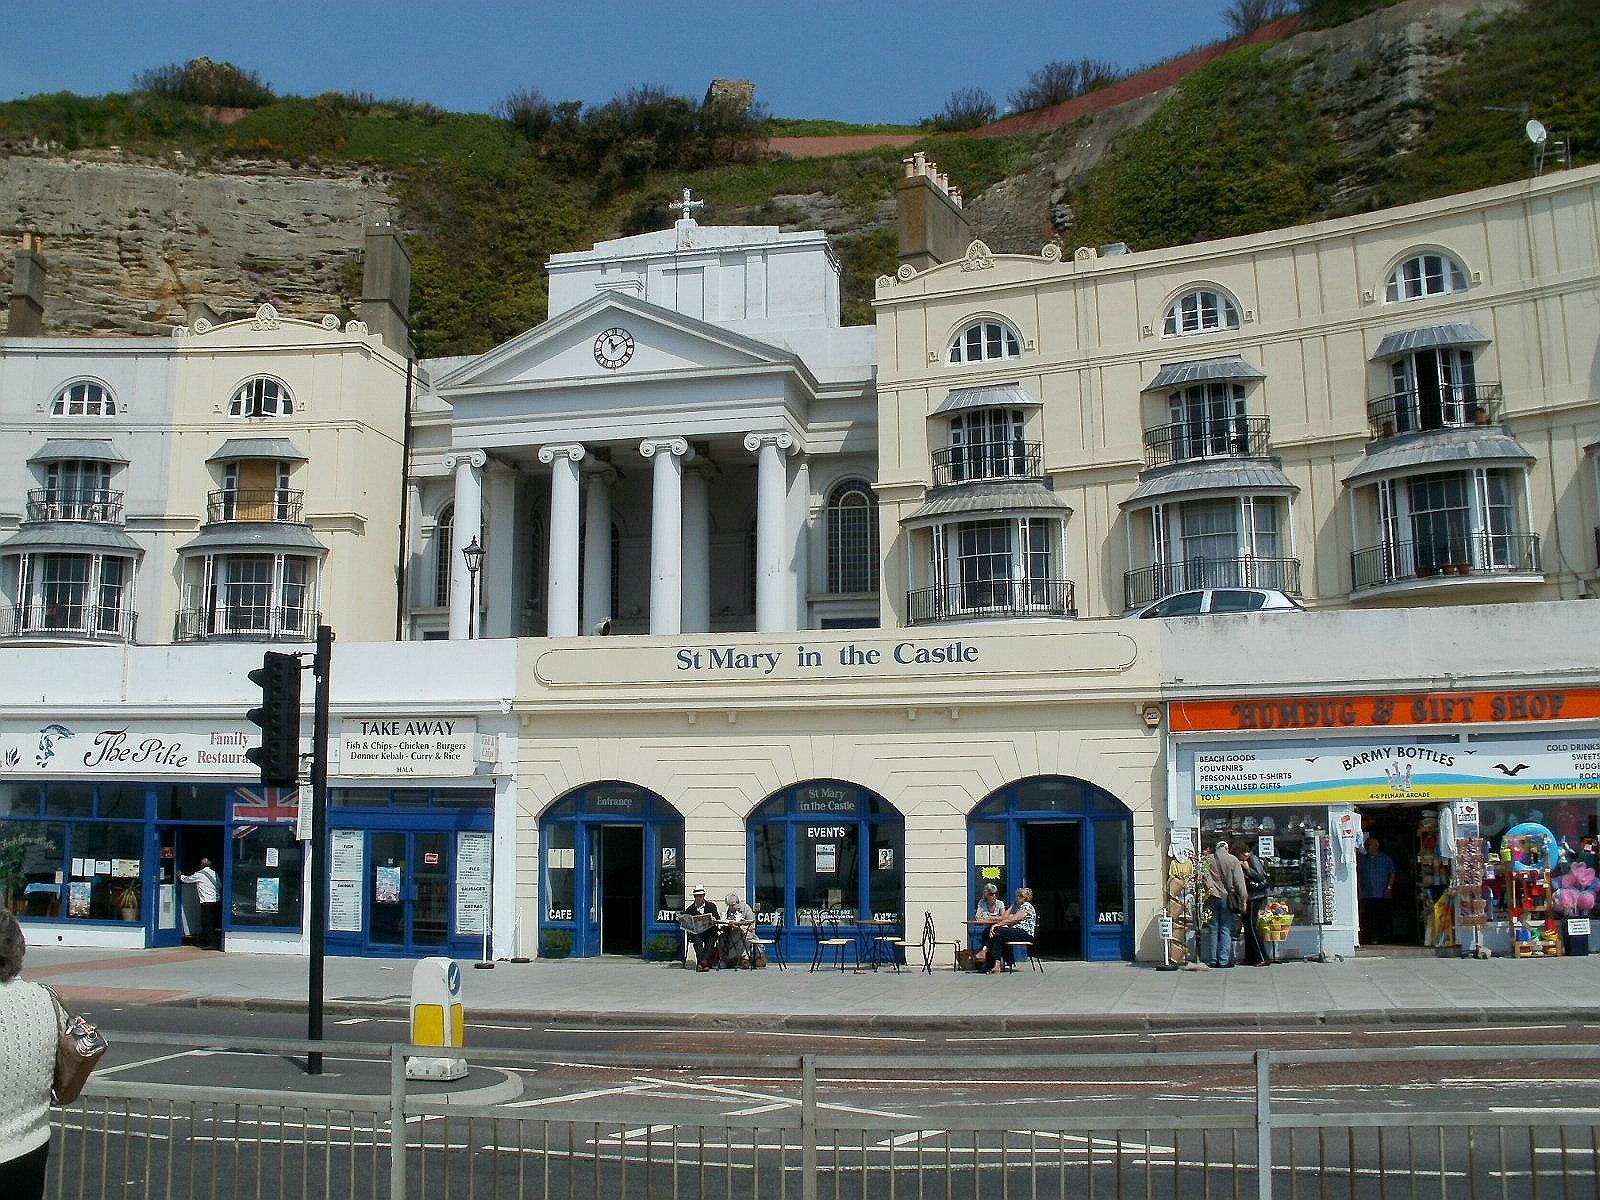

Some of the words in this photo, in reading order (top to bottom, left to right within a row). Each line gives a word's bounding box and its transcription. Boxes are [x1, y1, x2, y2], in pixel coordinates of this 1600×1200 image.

[676, 649, 703, 671] St
[708, 648, 783, 675] Mary
[797, 645, 823, 667] in
[839, 644, 881, 666] the
[893, 641, 979, 665] Castle
[1232, 701, 1357, 728] HUMBUG
[1371, 699, 1395, 724] &
[1411, 696, 1474, 722] GIFT
[1490, 693, 1567, 721] SHOP
[360, 721, 400, 736] TAKE
[404, 721, 456, 736] AWAY
[210, 731, 248, 748] Family
[84, 726, 130, 768] The
[132, 738, 188, 768] Pike
[346, 741, 362, 750] Fish
[370, 741, 392, 752] Chips
[399, 741, 429, 750] Chicken
[436, 742, 466, 752] Burgers
[1546, 744, 1568, 752] COLD
[1570, 743, 1600, 751] DRINKS
[196, 750, 253, 764] Restaura
[350, 752, 379, 760] Donner
[410, 752, 433, 762] Curry
[435, 752, 441, 760] &
[443, 752, 461, 760] Rice
[1199, 755, 1225, 763] BEACH
[1226, 754, 1256, 762] GOODS
[1342, 747, 1392, 771] BARMY
[1397, 747, 1455, 767] BOTTLES
[1199, 764, 1244, 772] SOUVENIRS
[1200, 773, 1257, 782] PERSONALISED
[1259, 772, 1292, 780] T-SHIRTS
[1200, 783, 1257, 791] PERSONALISED
[1259, 782, 1281, 790] GIFTS
[1552, 782, 1577, 790] MUCH
[808, 788, 818, 799] St
[821, 788, 846, 800] Mary
[1200, 793, 1221, 801] TOYS
[597, 796, 632, 806] Entrance
[800, 802, 810, 811] in
[811, 801, 827, 811] the
[828, 801, 855, 811] Castle
[807, 827, 845, 838] EVENTS
[549, 909, 572, 920] CAFE
[1098, 911, 1124, 922] ARTS
